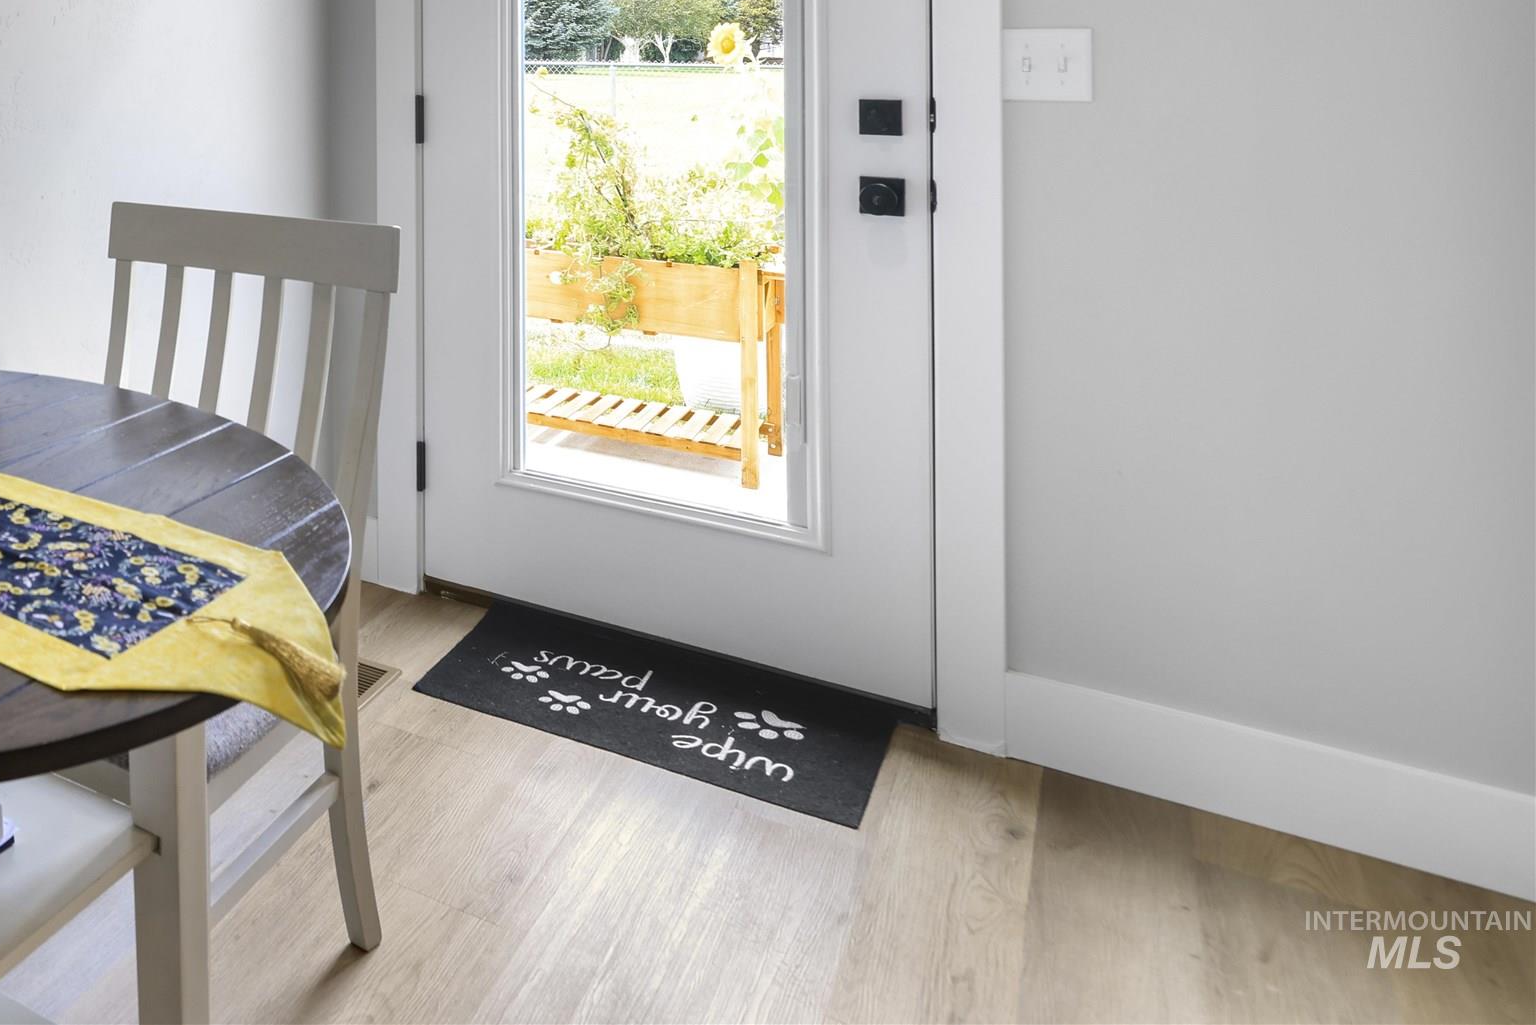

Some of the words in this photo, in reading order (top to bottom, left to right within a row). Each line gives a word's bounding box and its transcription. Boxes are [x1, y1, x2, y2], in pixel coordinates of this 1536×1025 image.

[532, 649, 654, 691] paws
[598, 690, 718, 729] your
[670, 733, 795, 783] wipe
